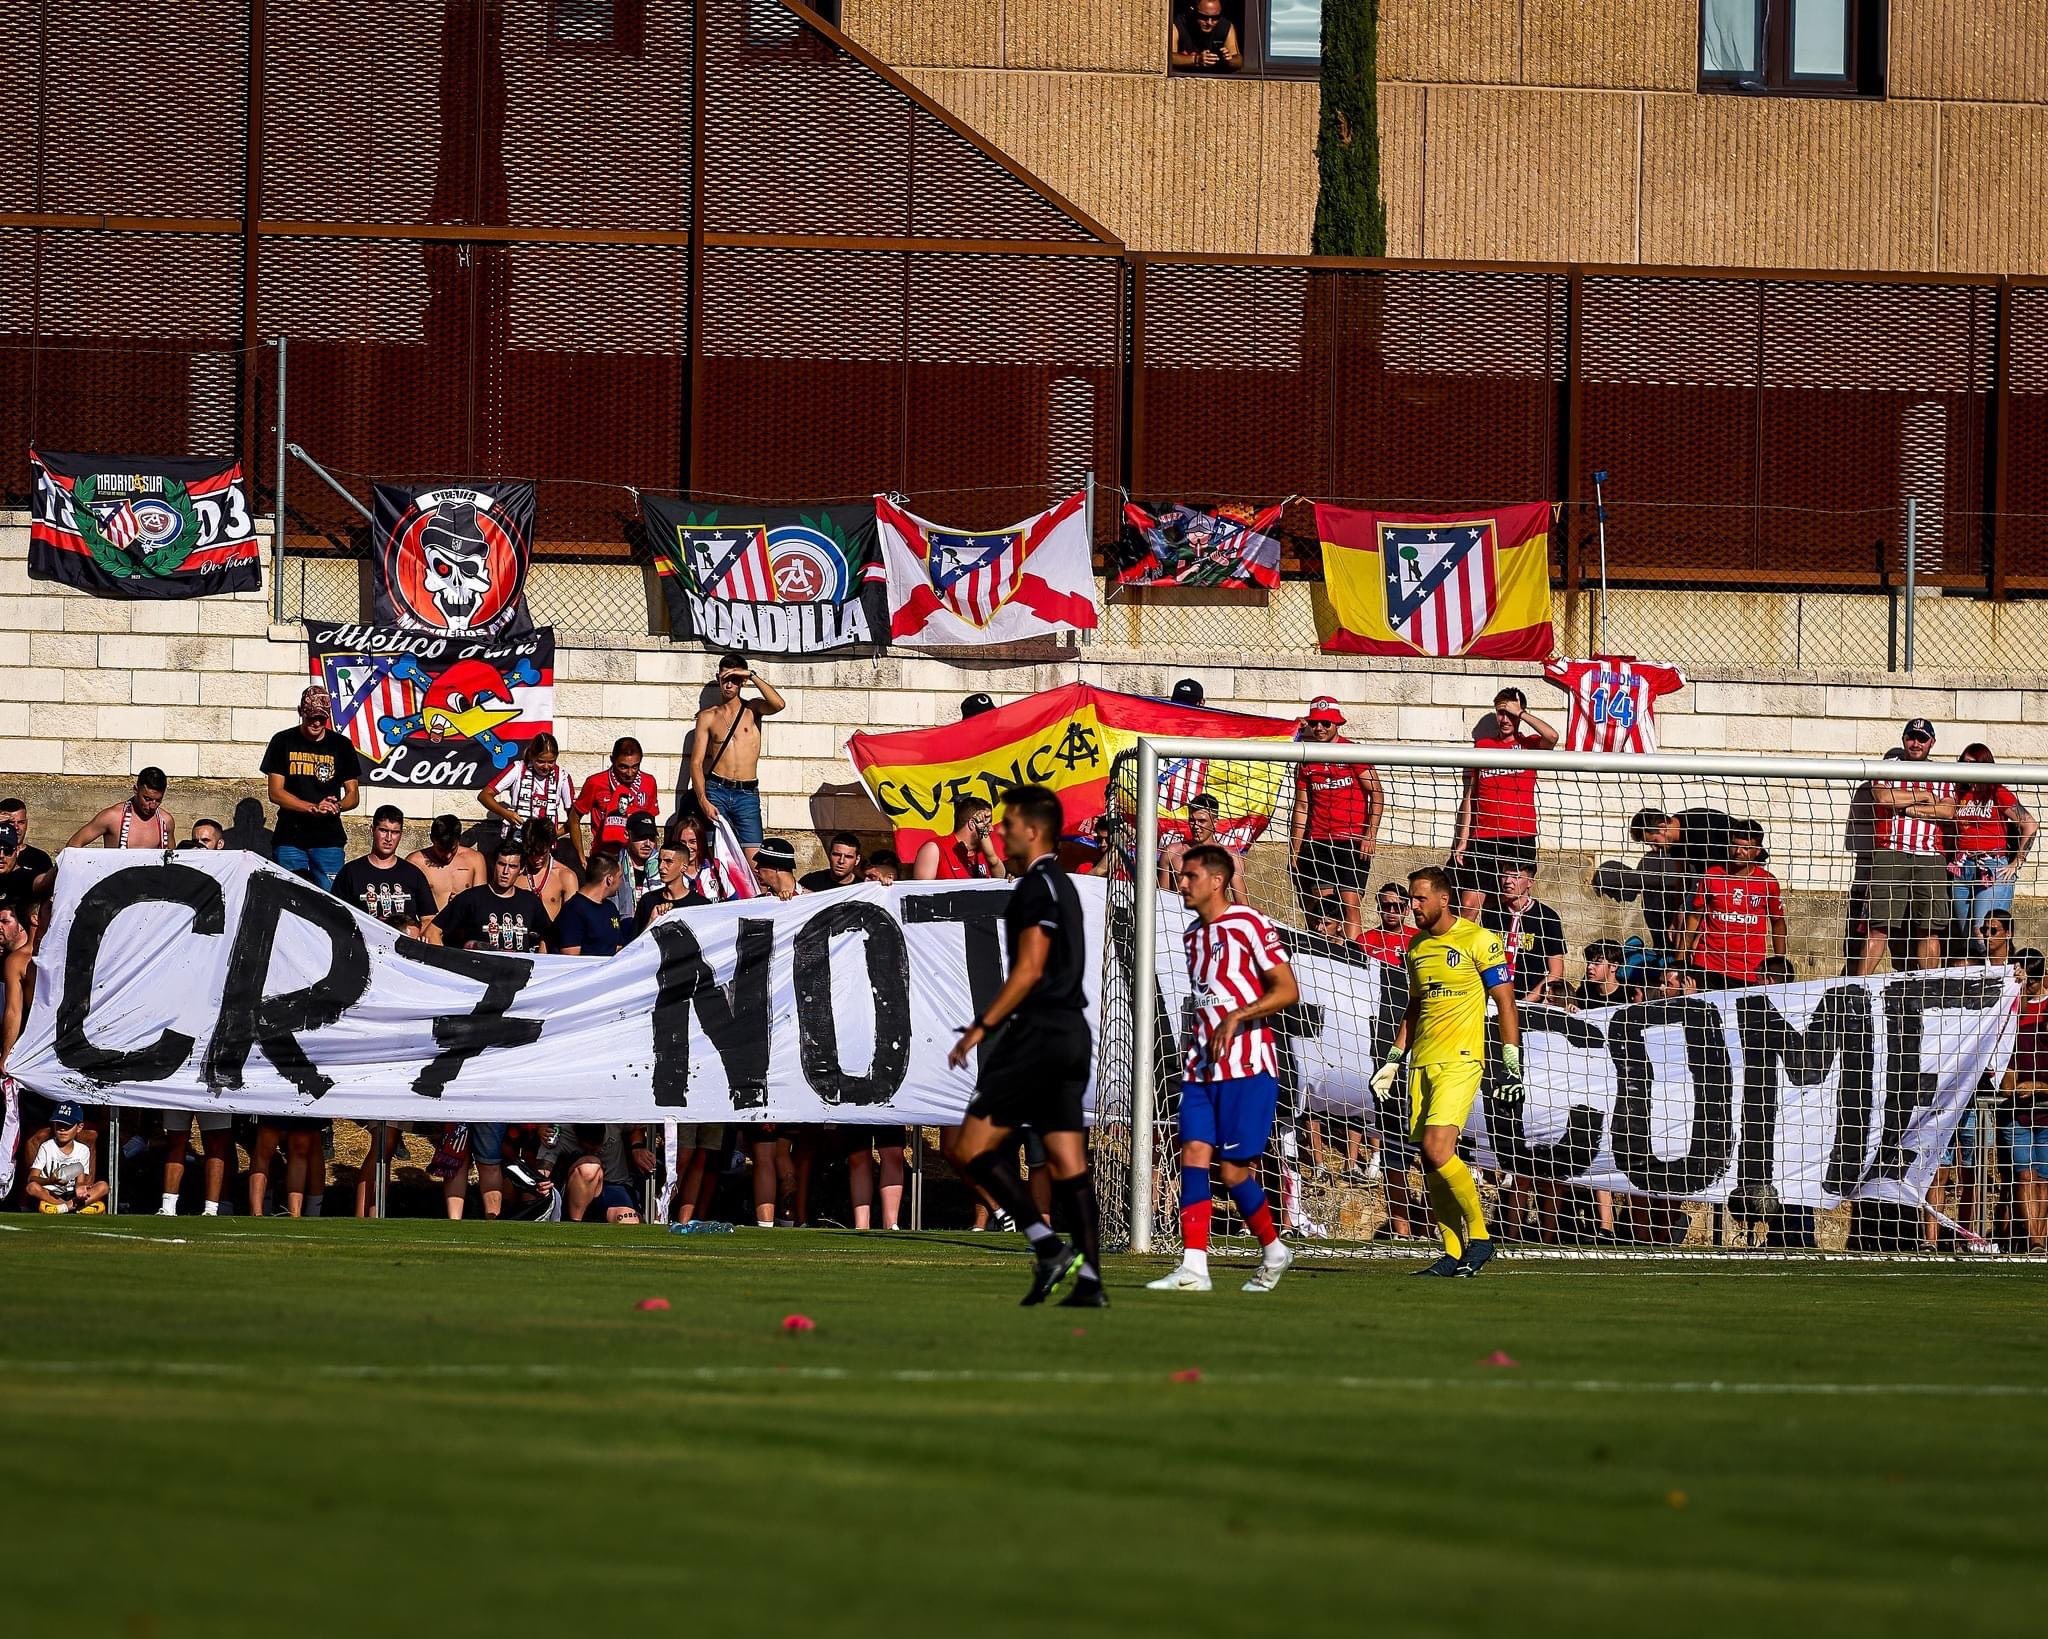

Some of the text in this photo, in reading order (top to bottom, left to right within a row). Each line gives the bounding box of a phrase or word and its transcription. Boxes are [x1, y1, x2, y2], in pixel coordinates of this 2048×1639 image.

[96, 473, 136, 491] MADRID
[224, 551, 255, 573] Tour
[1591, 687, 1634, 729] 14
[369, 745, 479, 787] León
[52, 862, 547, 1100] CR7
[650, 887, 1016, 1111] NOT
